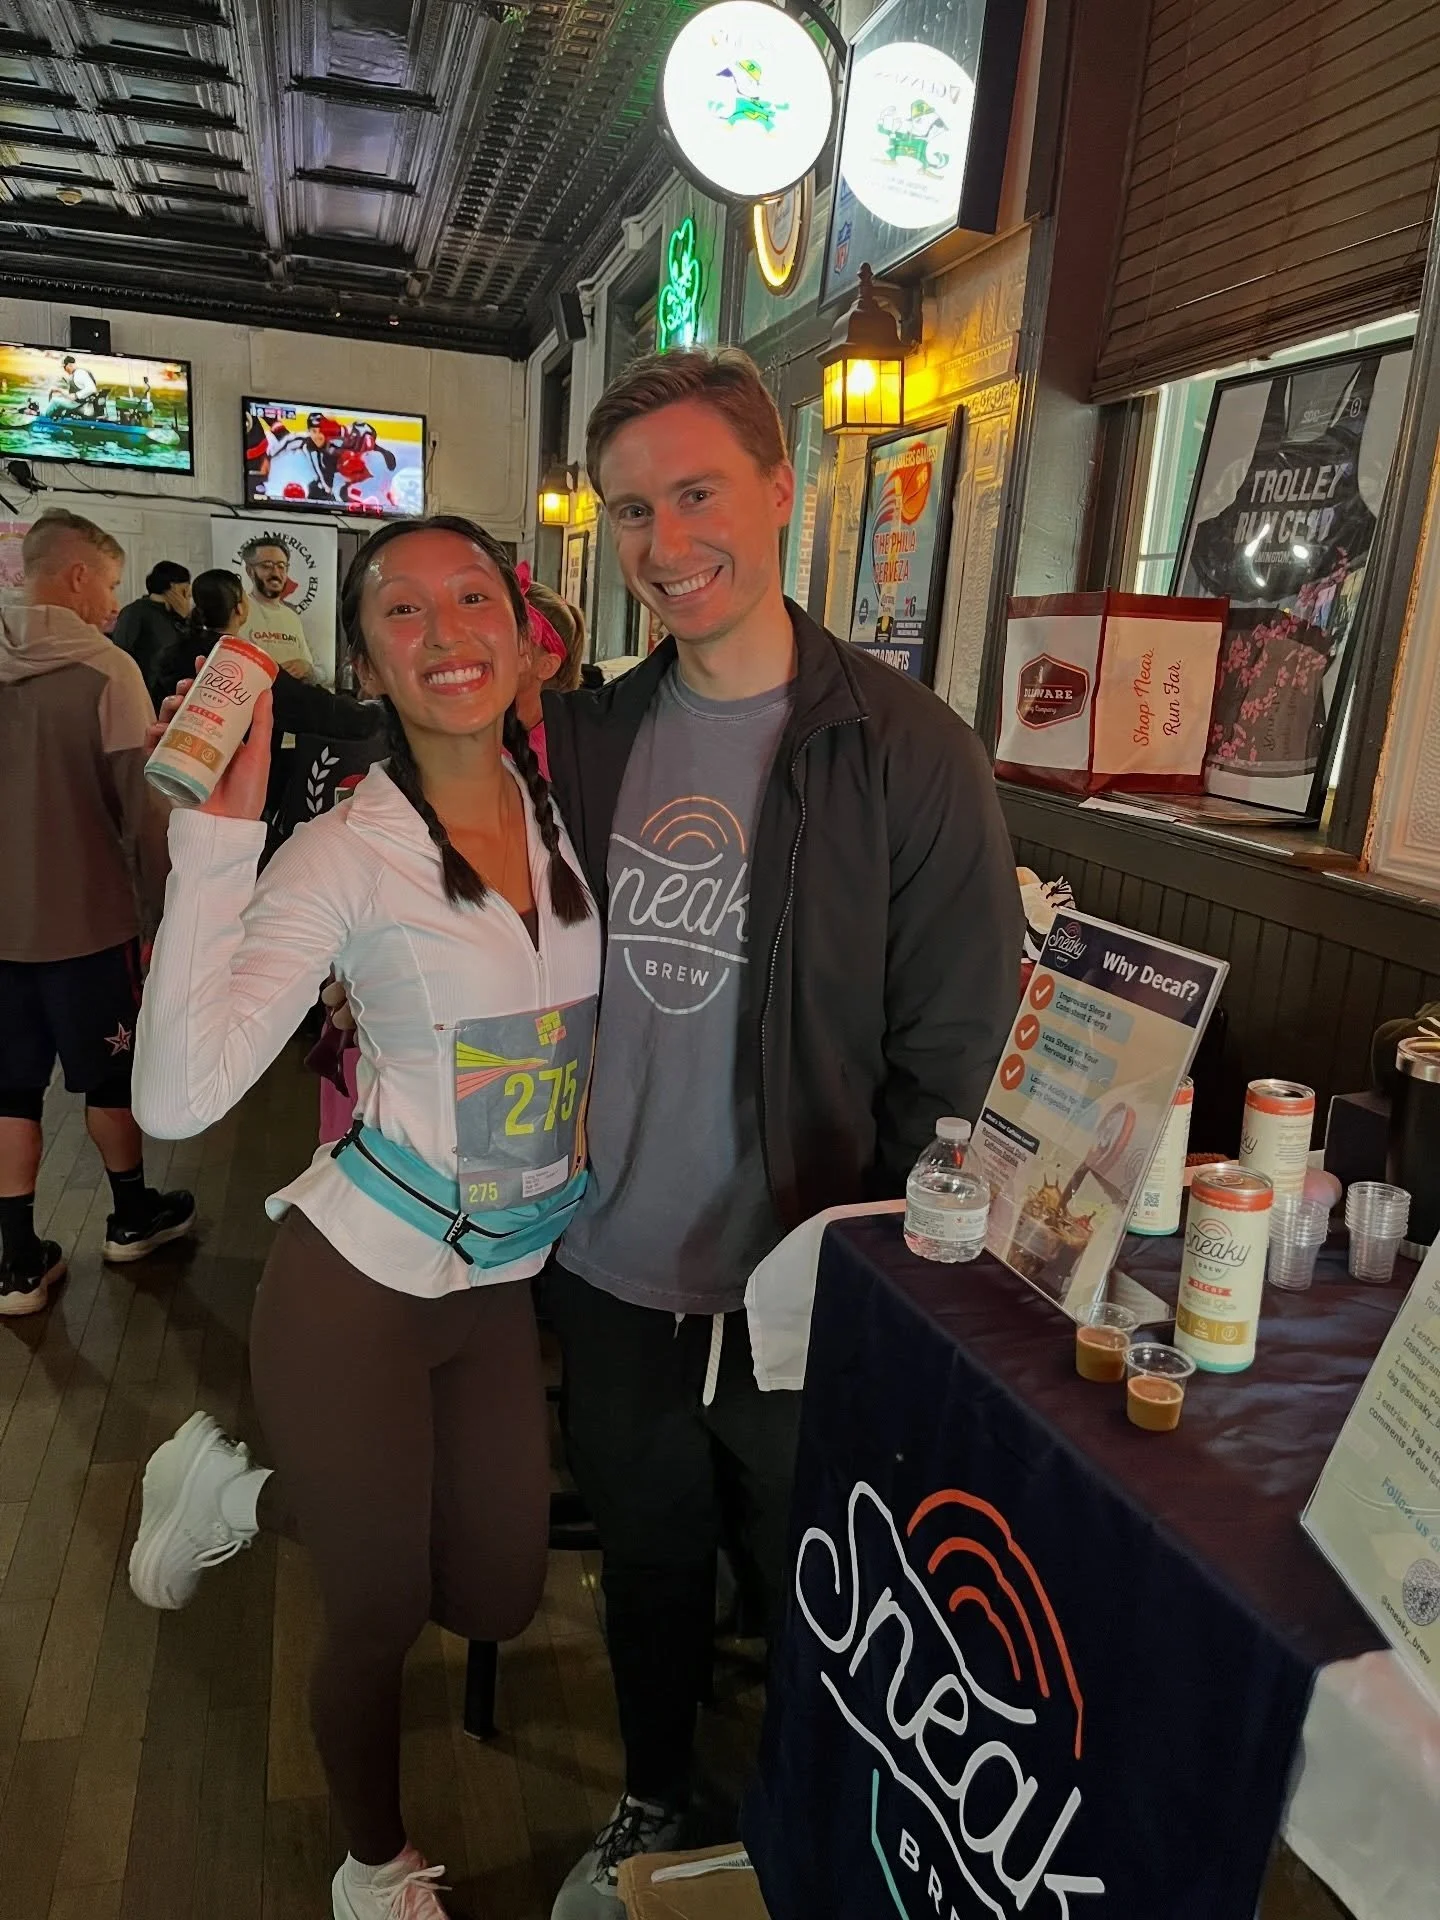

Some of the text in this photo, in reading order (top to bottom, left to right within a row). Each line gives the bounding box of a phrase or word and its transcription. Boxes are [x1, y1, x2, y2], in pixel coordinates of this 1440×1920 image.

[1250, 463, 1350, 503] TROLLEY
[263, 531, 317, 570] AMERICAN
[875, 533, 890, 556] THE
[875, 559, 910, 585] CERVEZA
[295, 576, 319, 615] CENTER
[904, 595, 916, 618] 76
[198, 665, 252, 706] neaky
[1133, 647, 1156, 747] Shop Near.
[1162, 659, 1182, 736] Run Far.
[608, 838, 750, 944] neak
[1048, 927, 1088, 960] Sneaky
[645, 959, 710, 987] BREW
[1102, 951, 1200, 1002] Why Decaf?
[1060, 991, 1088, 1009] Improved
[1042, 1031, 1055, 1043] Less
[1056, 1036, 1075, 1053] Stress
[1083, 1050, 1099, 1065] Your
[1044, 1043, 1066, 1061] Nervous
[503, 1058, 578, 1136] 275
[468, 1181, 497, 1203] 275
[1387, 1369, 1398, 1388] tag
[1400, 1362, 1428, 1394] entries:
[1375, 1390, 1382, 1401] 3
[1411, 1427, 1425, 1450] Tag
[1368, 1405, 1406, 1449] comments
[1406, 1445, 1416, 1459] of
[1415, 1457, 1429, 1475] our
[1414, 1517, 1430, 1538] us
[1380, 1594, 1432, 1665] @sneaky_brew
[796, 1481, 1105, 1920] Sneak
[899, 1828, 961, 1920] BR
